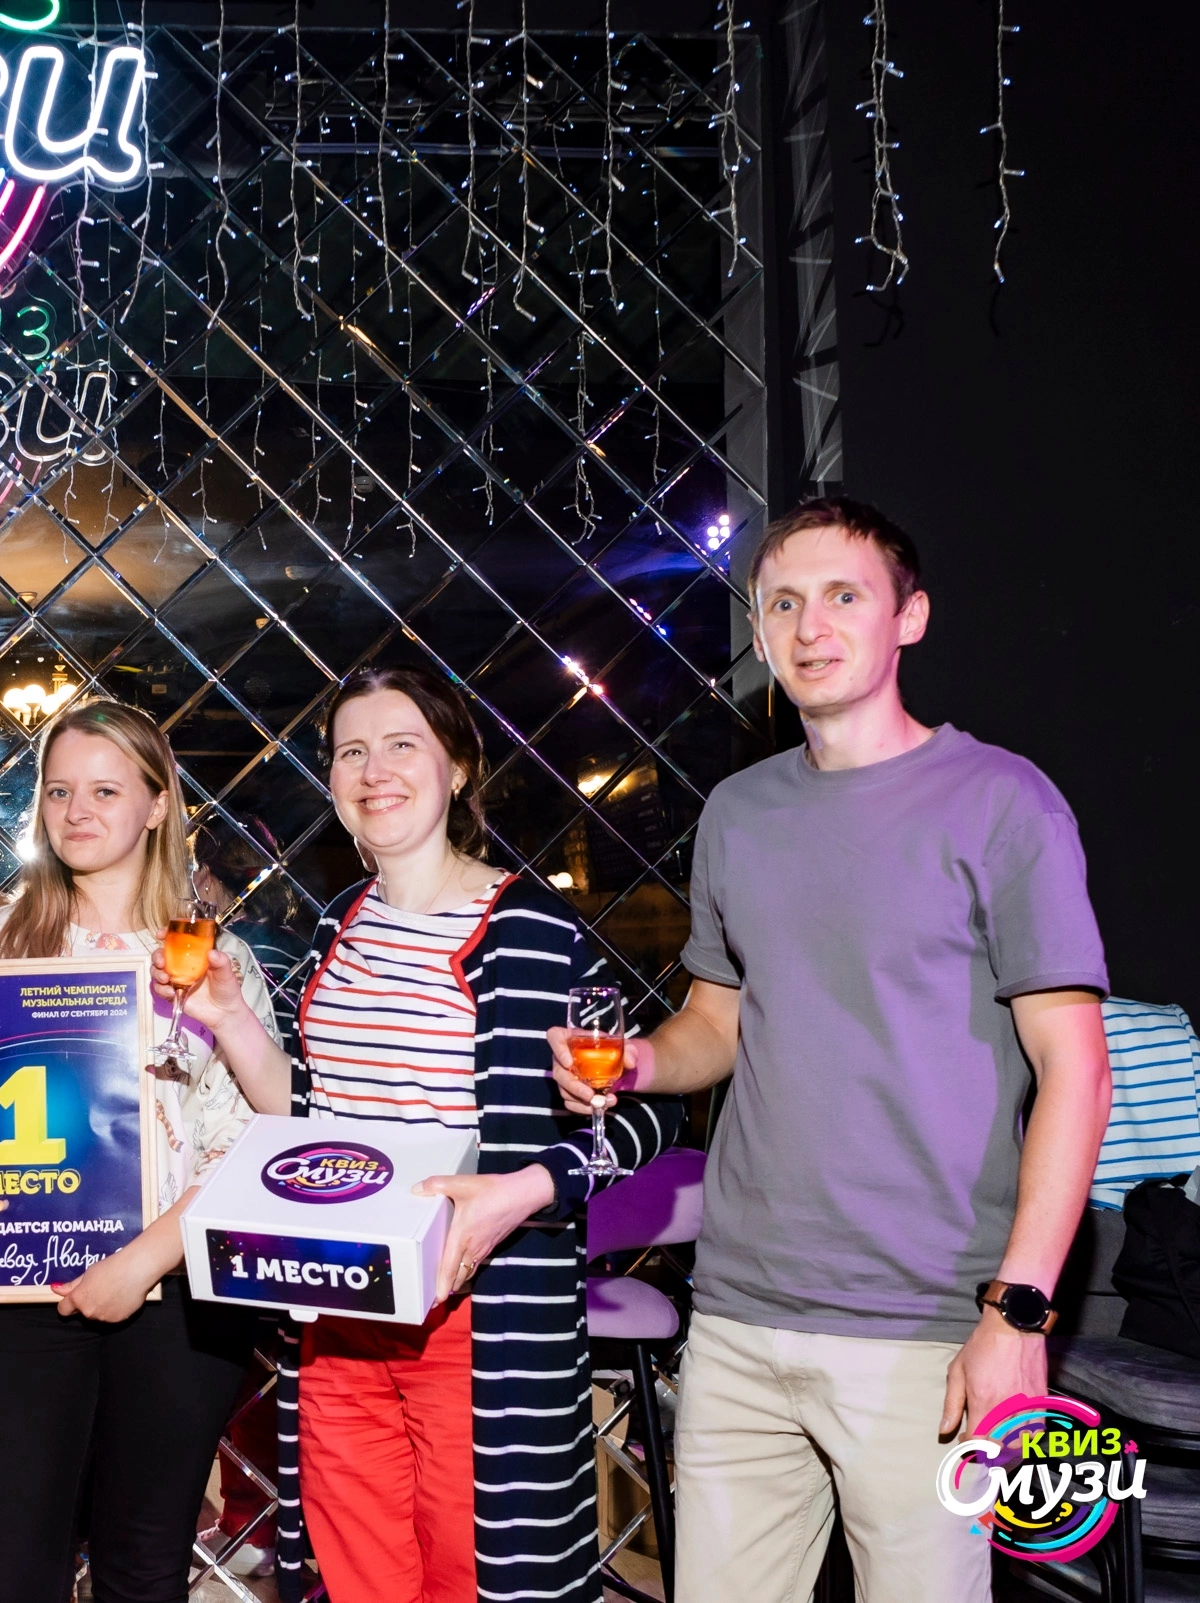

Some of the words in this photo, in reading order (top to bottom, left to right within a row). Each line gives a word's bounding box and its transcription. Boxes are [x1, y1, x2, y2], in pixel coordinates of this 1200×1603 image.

[20, 985, 61, 996] ЛЕТНИЙ
[63, 984, 127, 995] ЧЕМПИОНАТ
[22, 997, 94, 1008] МУЗЫКАЛЬНАЯ
[95, 996, 128, 1006] СРЕДА
[31, 1011, 60, 1019] ФИНАЛ
[70, 1009, 109, 1018] СЕНТЯБРЯ
[266, 1157, 390, 1185] Смузи
[319, 1158, 379, 1171] КВИЗ
[52, 1219, 125, 1234] КОМАНДА
[33, 1235, 123, 1286] Авар
[230, 1254, 249, 1279] 1
[256, 1256, 370, 1290] МЕСТО
